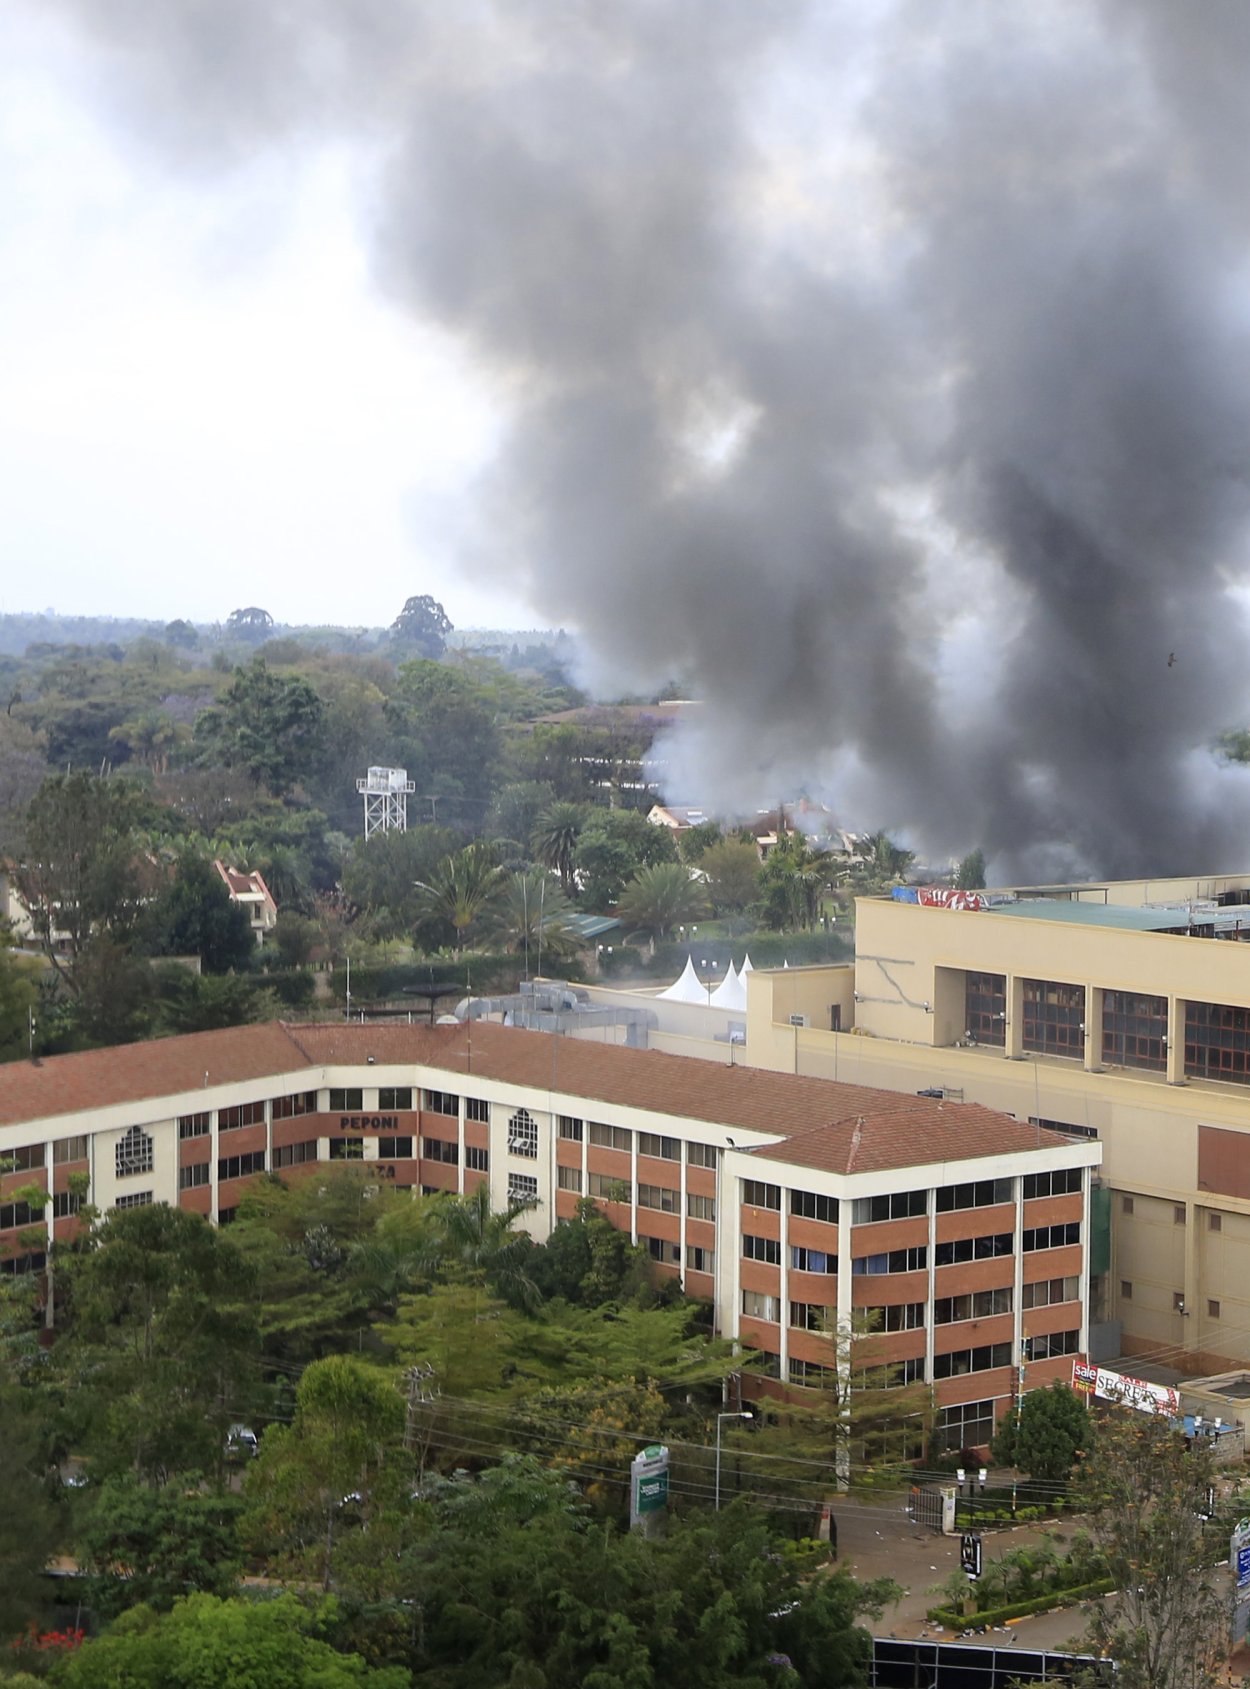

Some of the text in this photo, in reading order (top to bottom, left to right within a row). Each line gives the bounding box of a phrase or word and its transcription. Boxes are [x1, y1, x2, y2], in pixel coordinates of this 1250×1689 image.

[340, 1117, 399, 1129] PEPONI
[1075, 1365, 1096, 1380] sale
[1119, 1375, 1147, 1389] SALE
[1097, 1376, 1157, 1404] SECRETS
